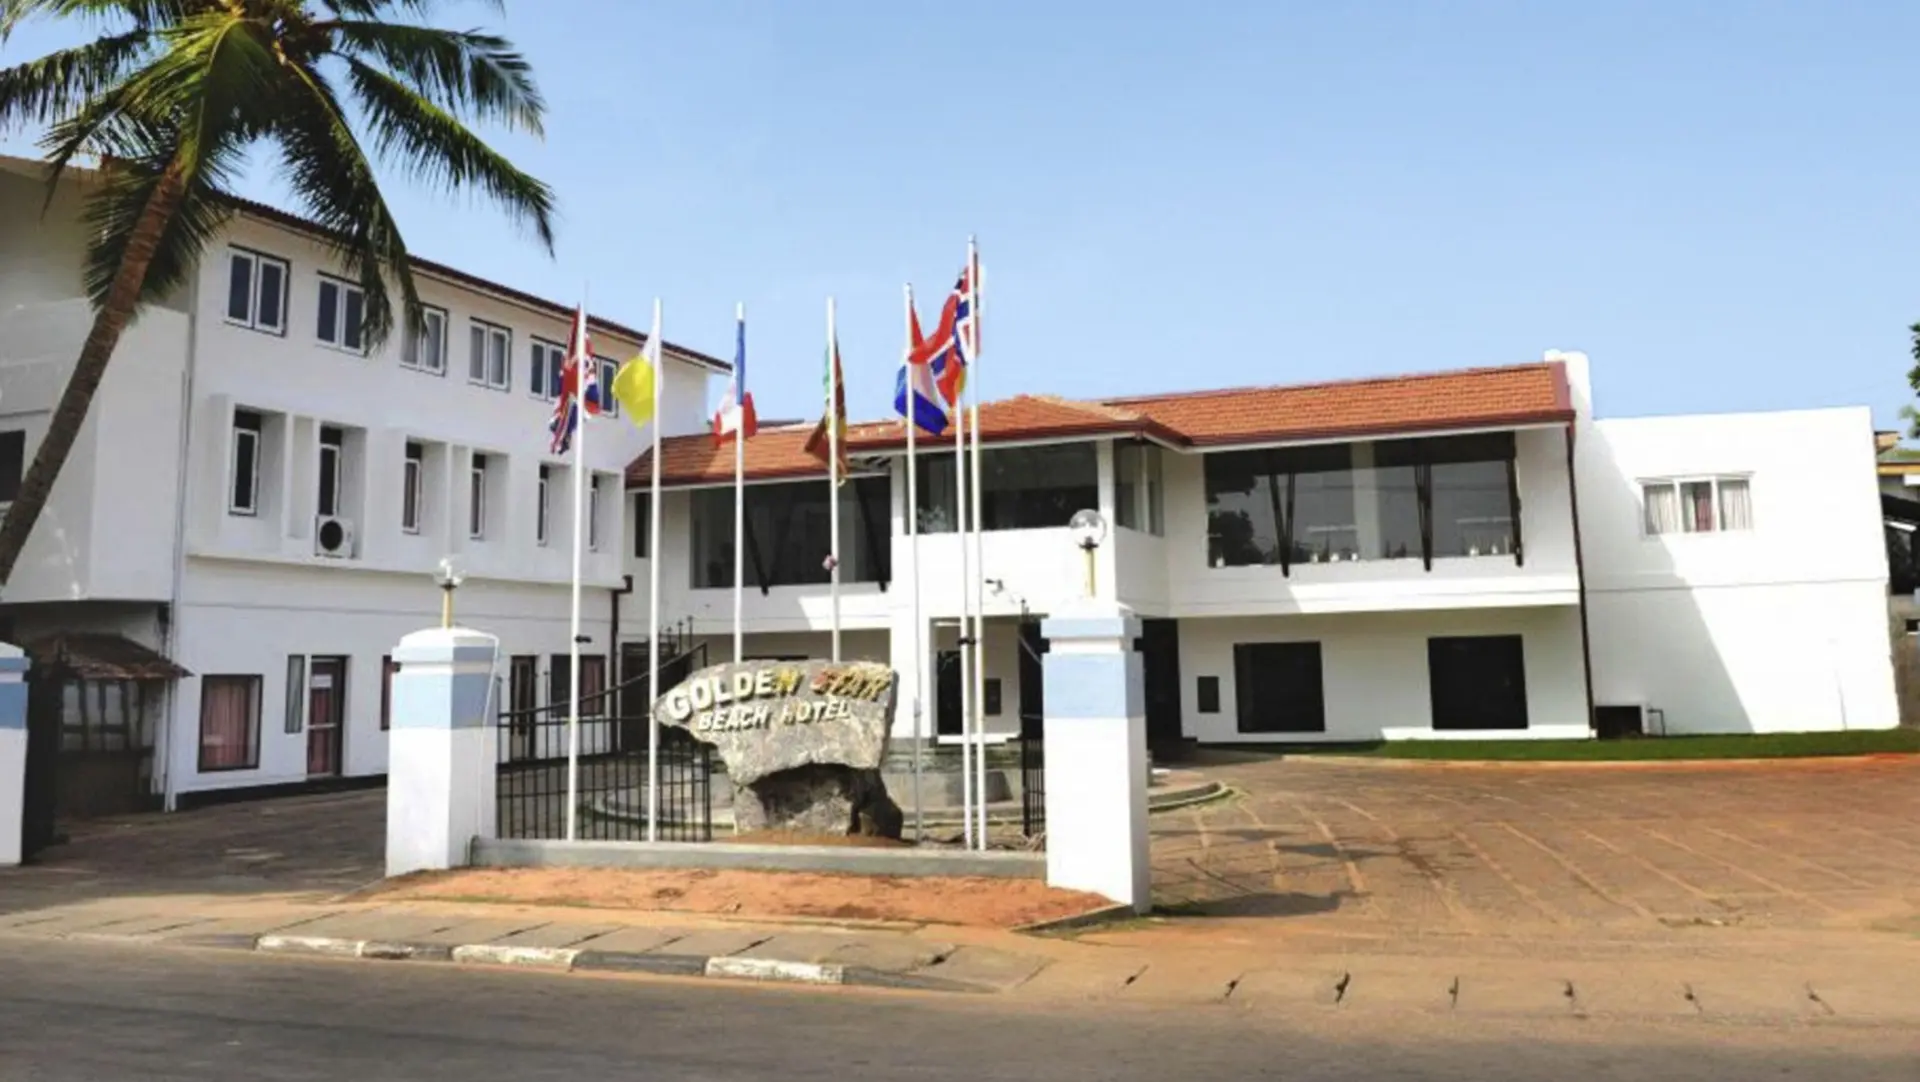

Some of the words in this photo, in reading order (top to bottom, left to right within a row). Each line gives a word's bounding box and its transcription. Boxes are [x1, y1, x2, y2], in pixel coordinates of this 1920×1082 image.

[666, 668, 801, 720] GOLDEN
[810, 667, 891, 701] STAR
[699, 705, 768, 732] BEACH
[781, 698, 850, 725] HOTEL
